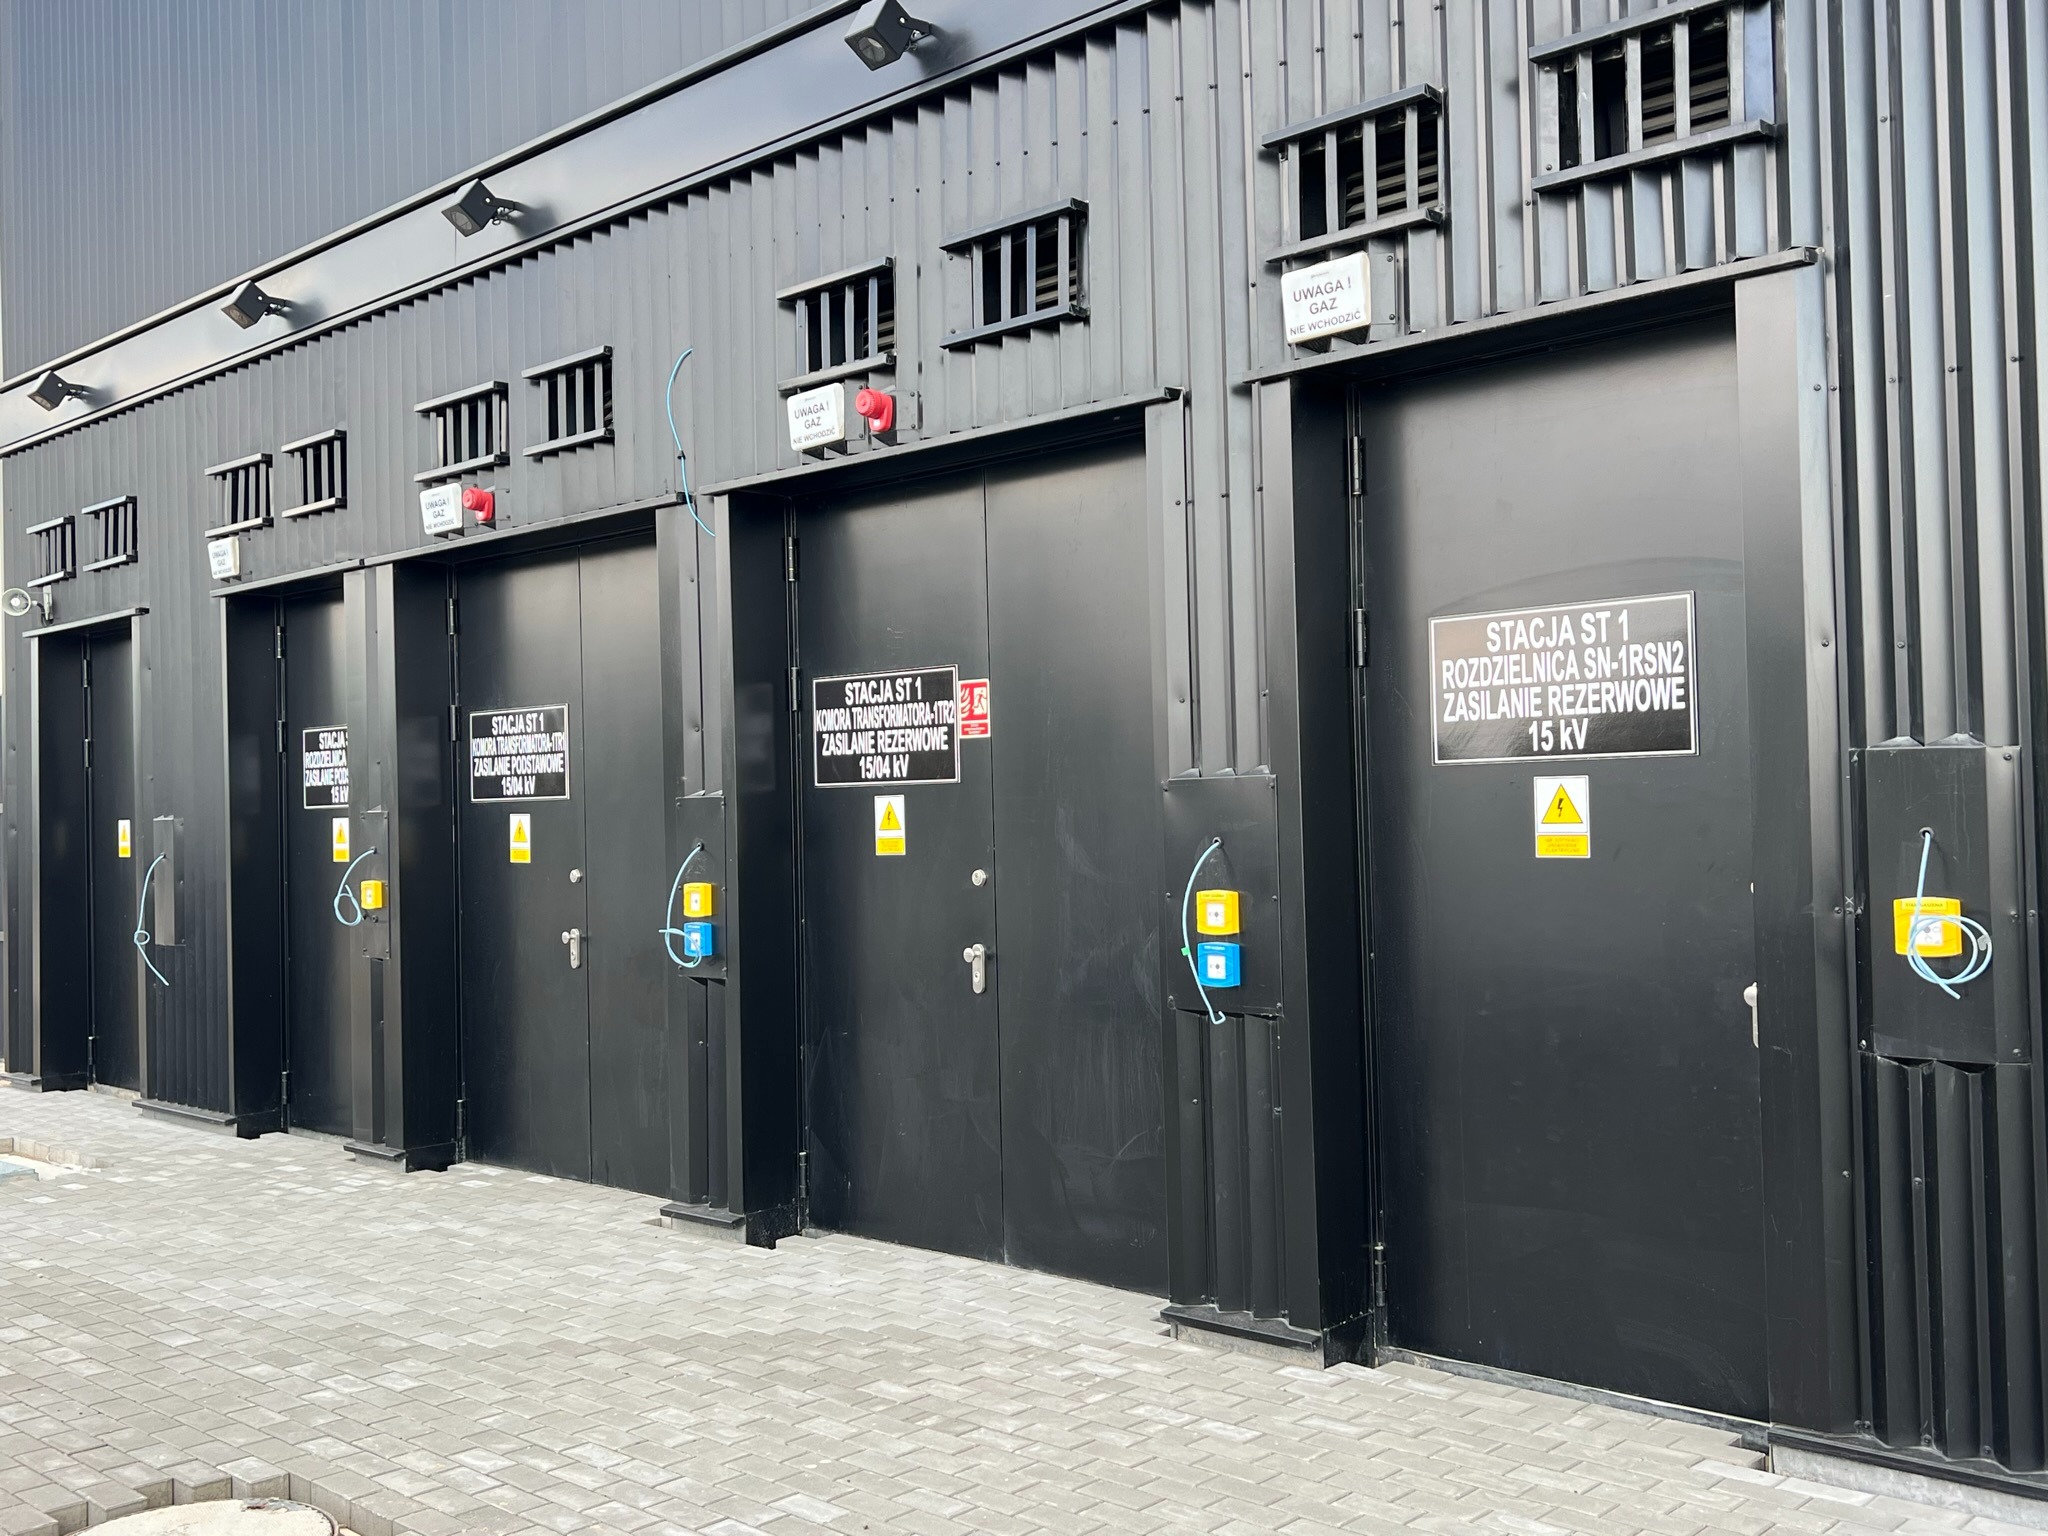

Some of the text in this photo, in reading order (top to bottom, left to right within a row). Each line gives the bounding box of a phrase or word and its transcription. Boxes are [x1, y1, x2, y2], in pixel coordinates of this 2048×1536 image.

[1293, 279, 1344, 302] UWAGA
[1309, 298, 1338, 315] GAZ
[1290, 308, 1361, 335] NIE WCHODZIĆ
[794, 403, 825, 419] UWAGA
[804, 417, 821, 429] GAZ
[1486, 609, 1628, 652] STACJA ST 1
[1442, 640, 1685, 689] ROZDZIELNICA SN-1RSN2
[845, 676, 922, 705] STACJA ST 1
[1443, 676, 1686, 722] ZASILANIE REZERWOWE
[491, 712, 544, 735] STACJA ST 1
[816, 707, 850, 732] KOMORA
[851, 700, 955, 730] TRANSFORMATORA-1TR2
[319, 731, 345, 749] STACJA
[822, 728, 875, 756] ZASILANIE
[877, 726, 948, 753] REZERWOWE
[1528, 718, 1588, 751] 15 kV
[472, 737, 497, 757] KOMORA
[305, 749, 347, 769] ROZDZIELNICA
[474, 753, 564, 777] ZASILANIE PODSTAWOWE
[859, 754, 909, 779] 15/04 kV
[305, 768, 334, 787] ZASILANIE
[501, 775, 536, 796] 15/04 kV
[331, 785, 339, 803] 15
